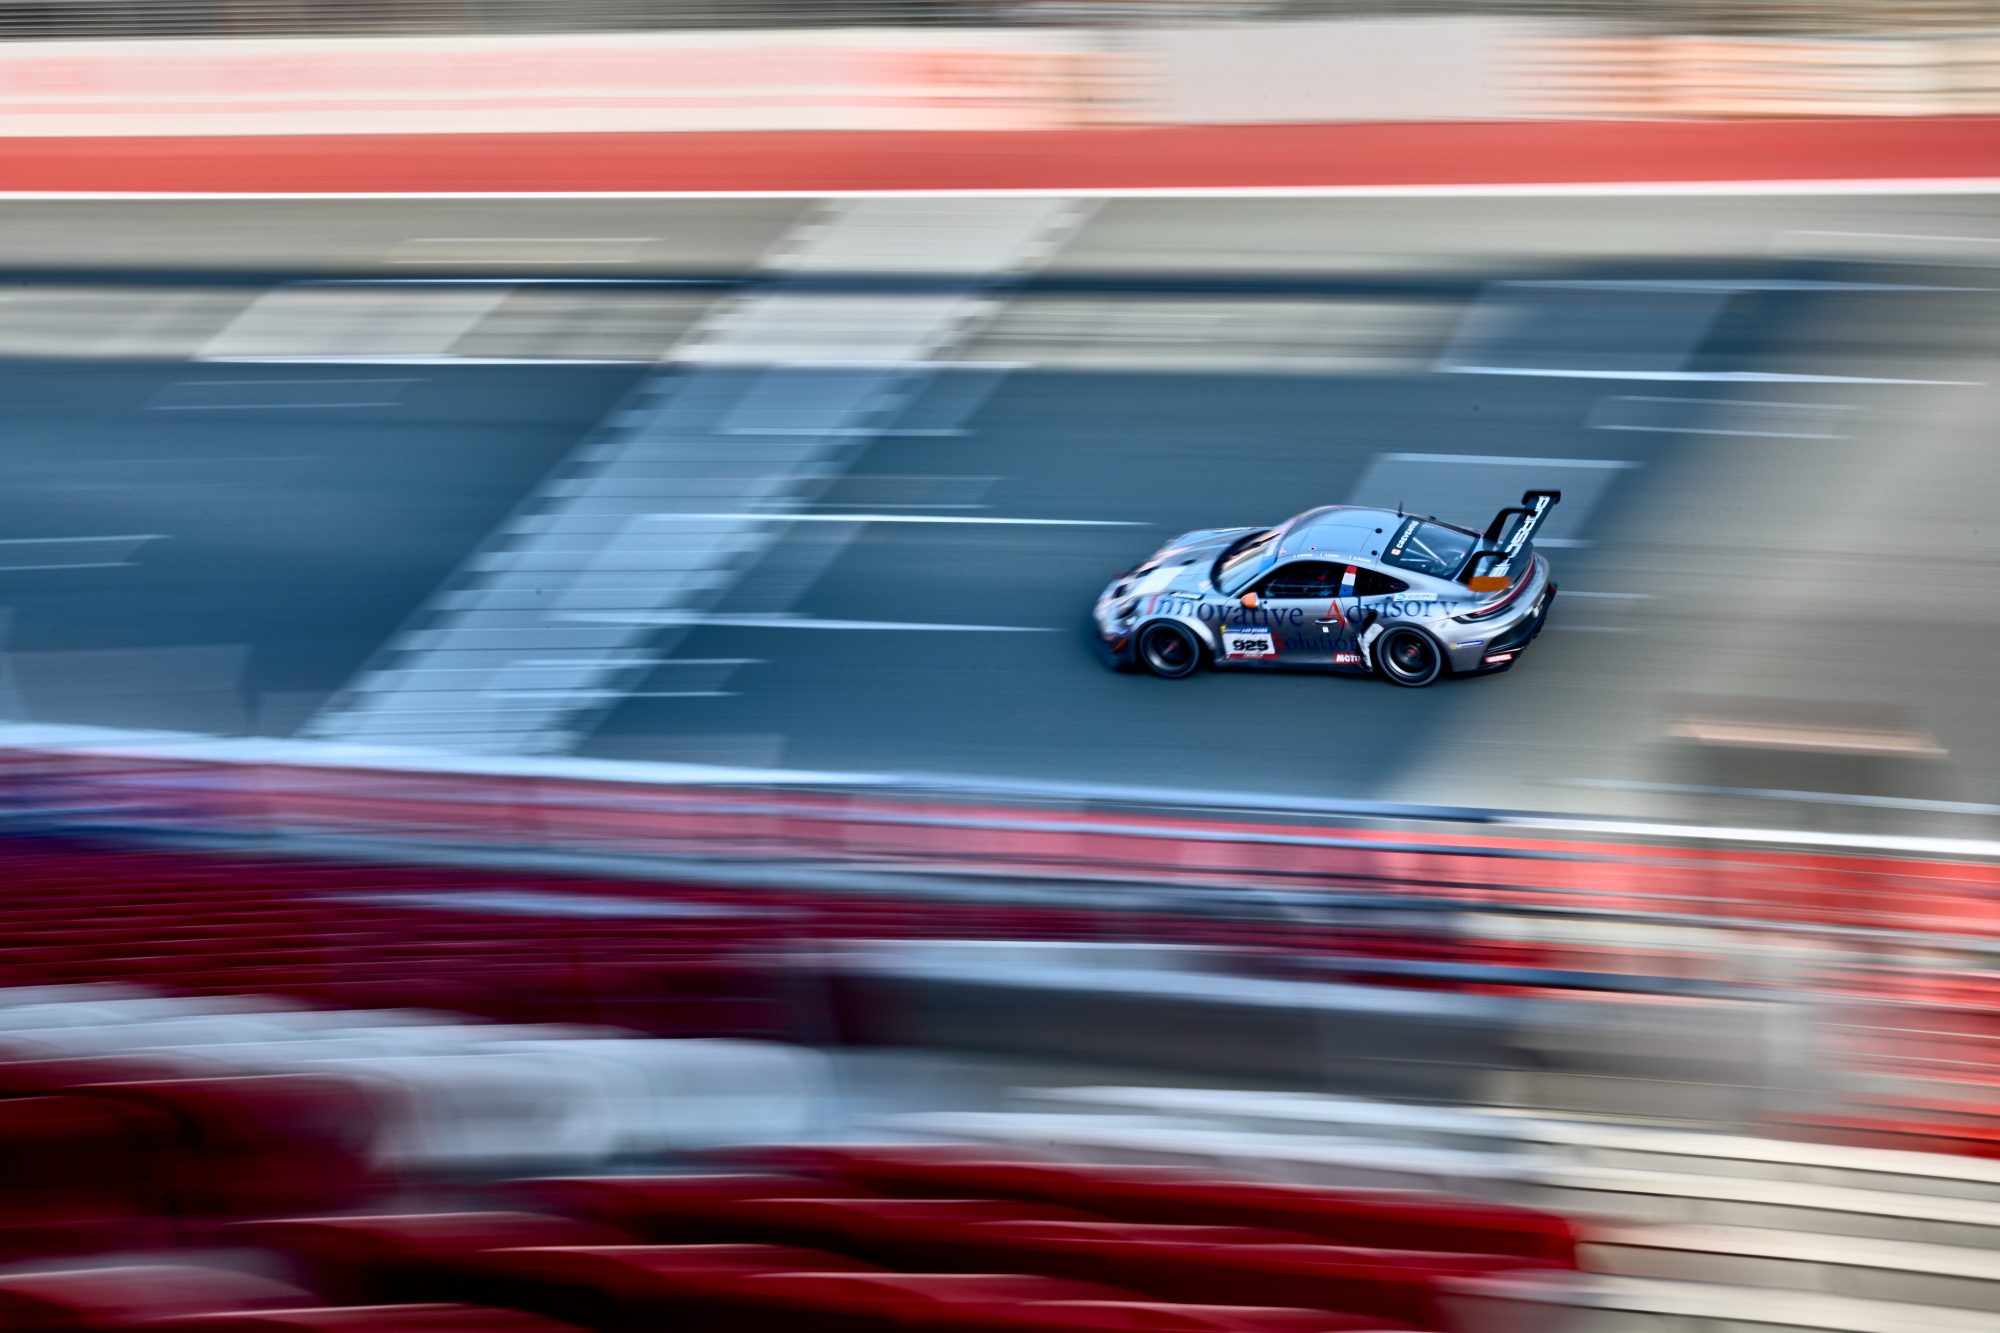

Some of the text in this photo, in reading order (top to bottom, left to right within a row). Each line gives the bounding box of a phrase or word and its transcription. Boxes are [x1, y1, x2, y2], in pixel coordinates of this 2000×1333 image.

[1144, 593, 1459, 627] Innovative Advisory
[1232, 639, 1269, 651] 925
